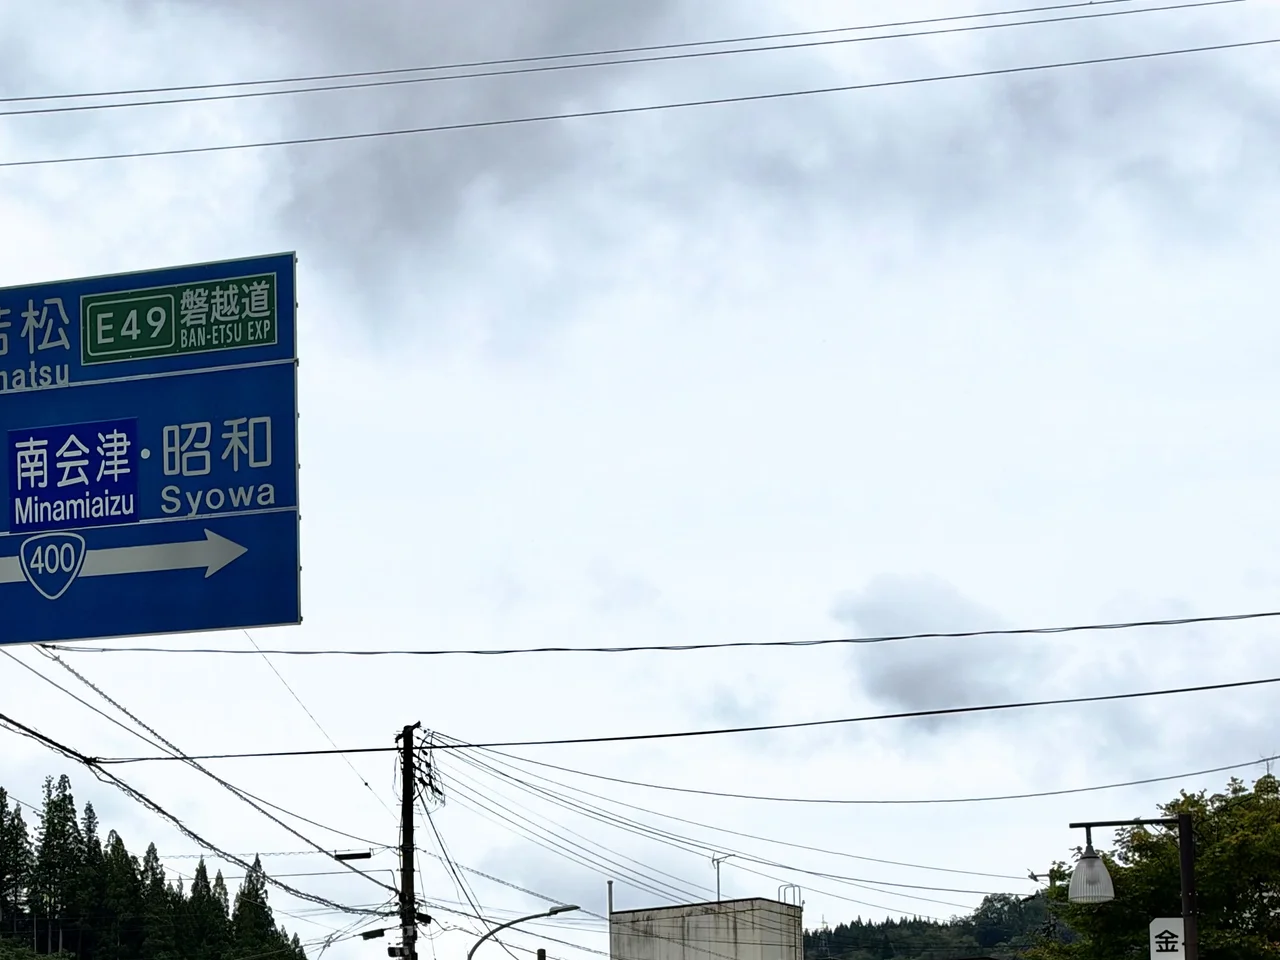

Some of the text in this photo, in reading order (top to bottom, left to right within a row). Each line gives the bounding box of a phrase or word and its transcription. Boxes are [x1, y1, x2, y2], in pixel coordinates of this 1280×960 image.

[180, 281, 272, 327] 磐越道
[96, 307, 168, 345] E49
[180, 319, 272, 349] BAN-ETSU EXP
[14, 490, 134, 525] Minamiaizu
[161, 484, 275, 517] Syowa
[29, 544, 75, 574] 400
